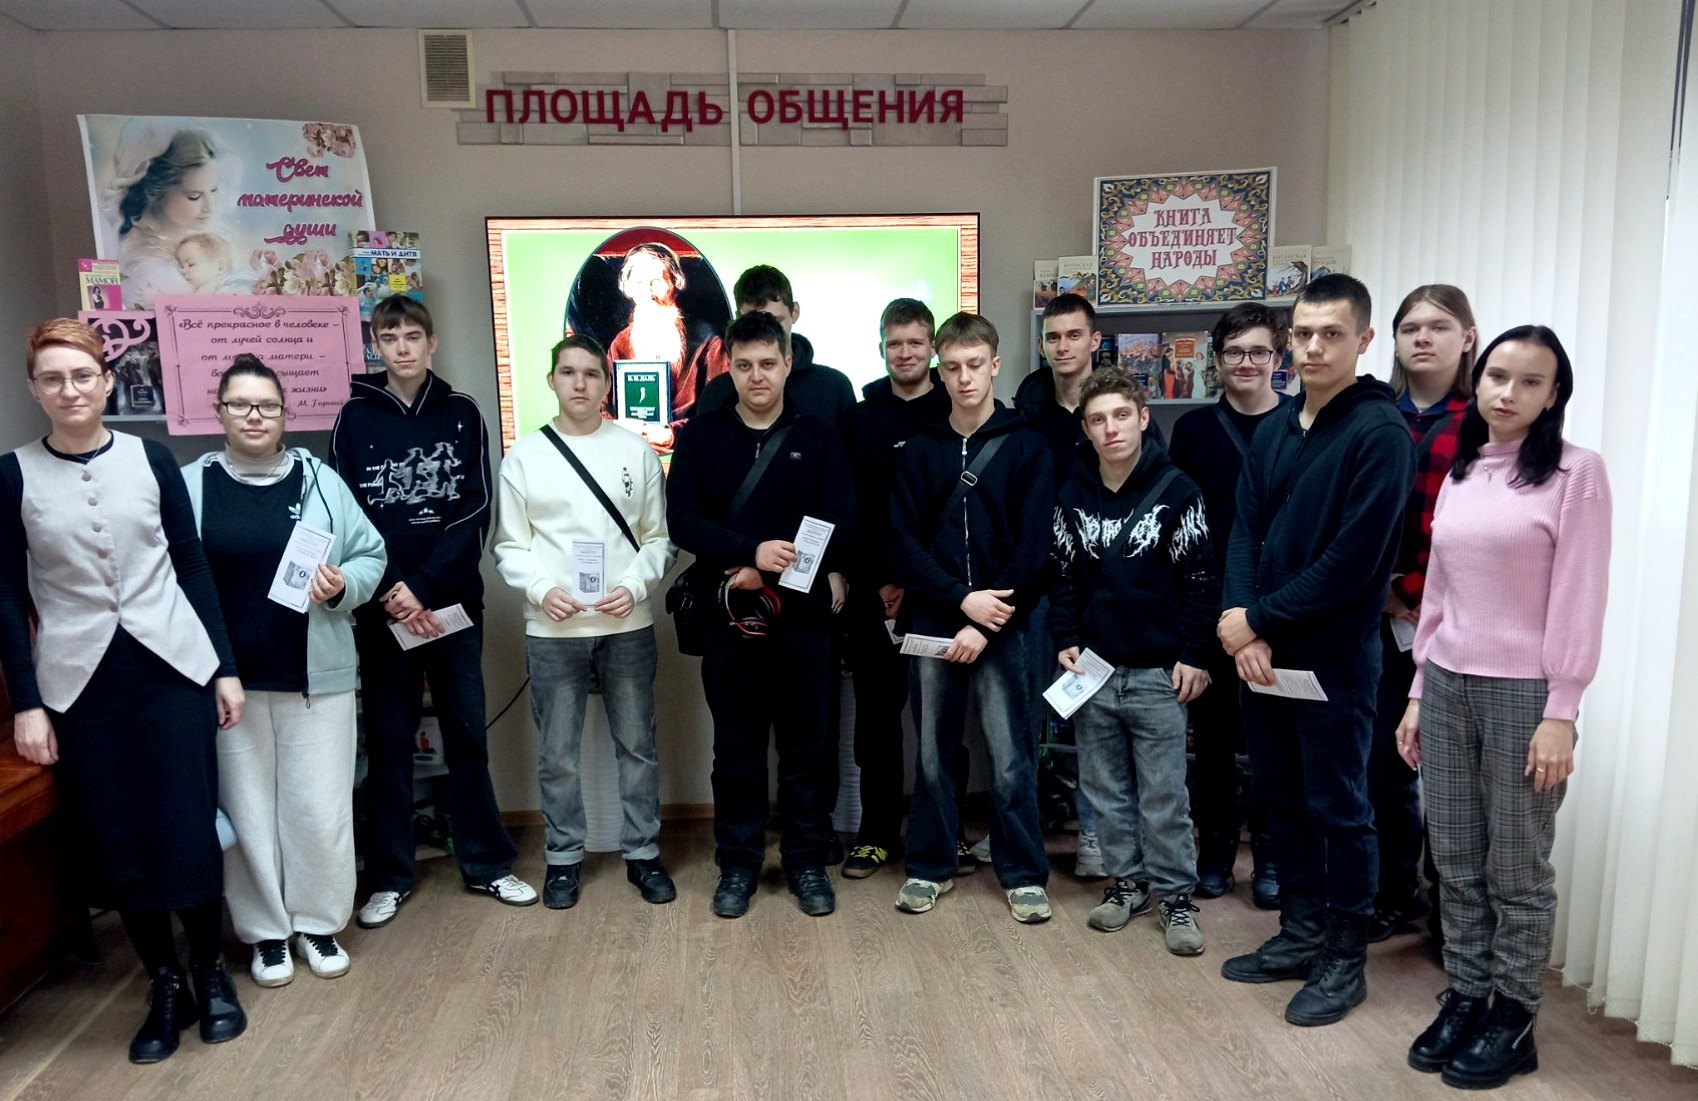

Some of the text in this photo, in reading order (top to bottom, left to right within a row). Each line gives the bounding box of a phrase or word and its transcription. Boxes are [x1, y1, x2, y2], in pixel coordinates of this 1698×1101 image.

[486, 89, 964, 132] ПЛОЩАДЬ ОБЩЕНИЯ
[266, 156, 328, 183] Свет
[237, 189, 363, 212] материнской
[1154, 207, 1212, 228] КНИГА
[264, 223, 336, 245] души
[1128, 227, 1237, 249] ОБЪЕДИНЯЕТ
[1150, 249, 1217, 270] НАРОДЫ
[207, 321, 271, 331] прекрасное
[274, 319, 281, 328] в
[283, 321, 329, 329] человеке
[231, 336, 262, 346] лучей
[266, 337, 303, 345] солнца
[268, 354, 313, 363] матери
